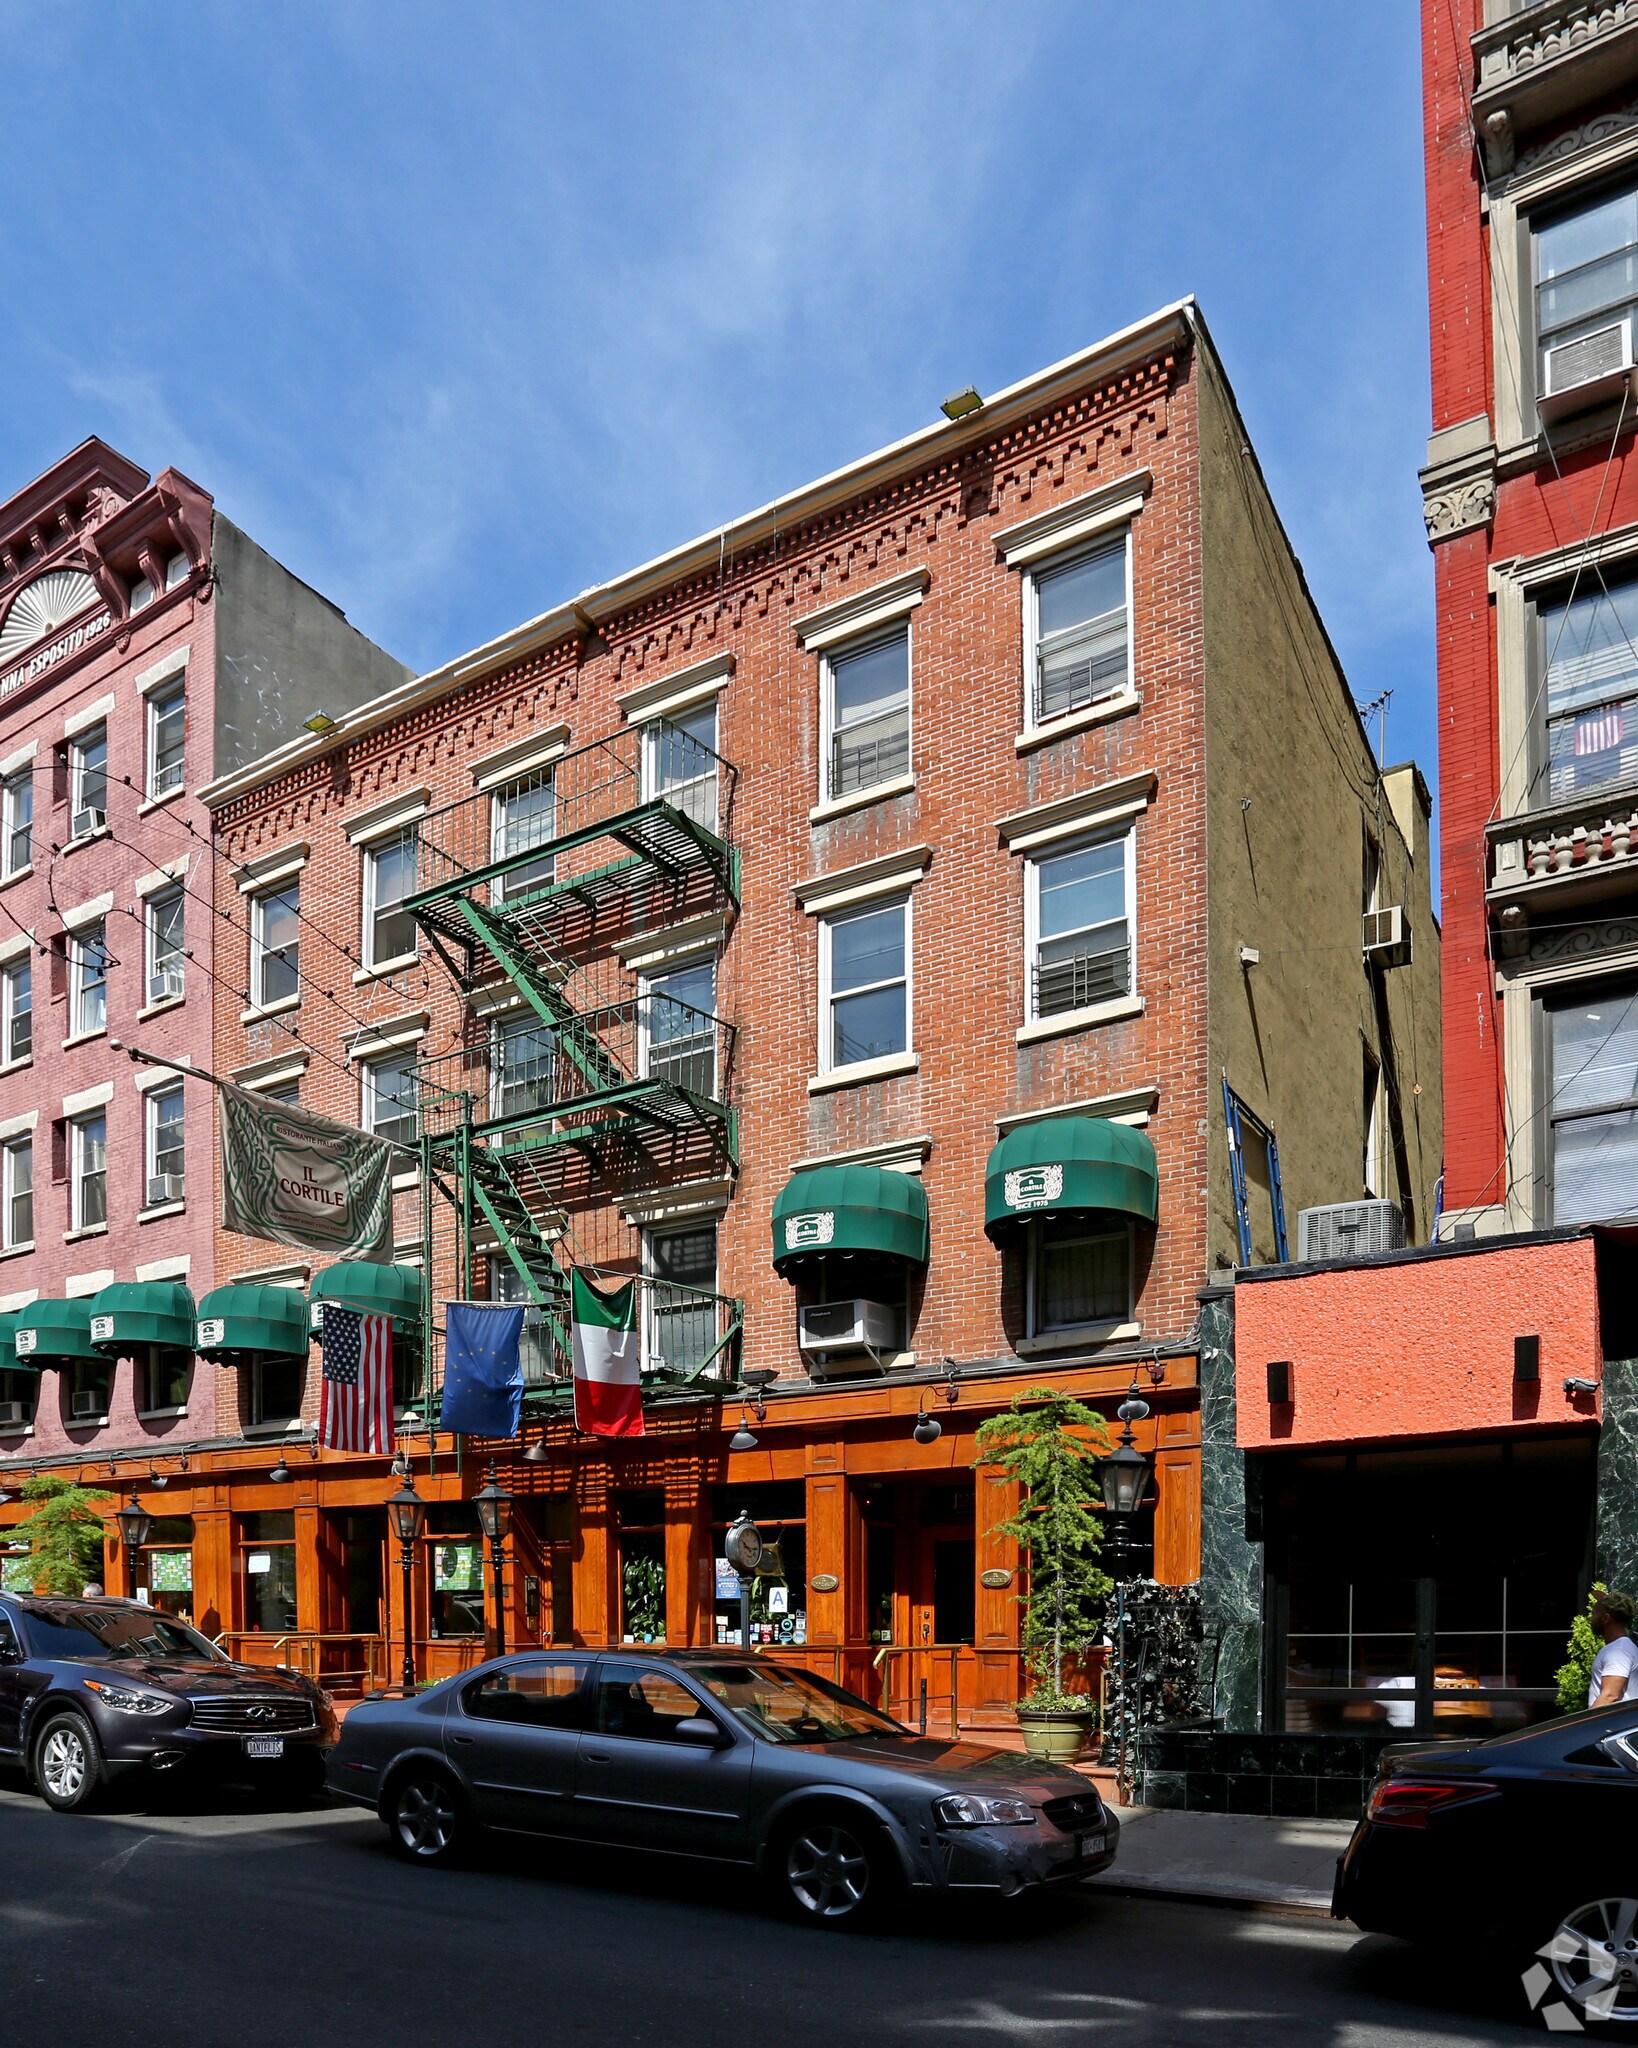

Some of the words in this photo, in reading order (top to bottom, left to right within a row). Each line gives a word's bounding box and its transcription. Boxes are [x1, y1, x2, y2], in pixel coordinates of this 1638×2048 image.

[29, 628, 83, 677] ESPOSITO
[85, 612, 111, 639] 1926
[276, 1125, 316, 1144] RISTORANTE
[317, 1138, 346, 1152] ITALIANO
[303, 1166, 318, 1183] IL
[280, 1178, 345, 1207] CORTILE
[1020, 1184, 1043, 1193] CORTILE
[1015, 1202, 1032, 1211] SINCE
[1033, 1200, 1049, 1208] 1975
[772, 1590, 784, 1606] A
